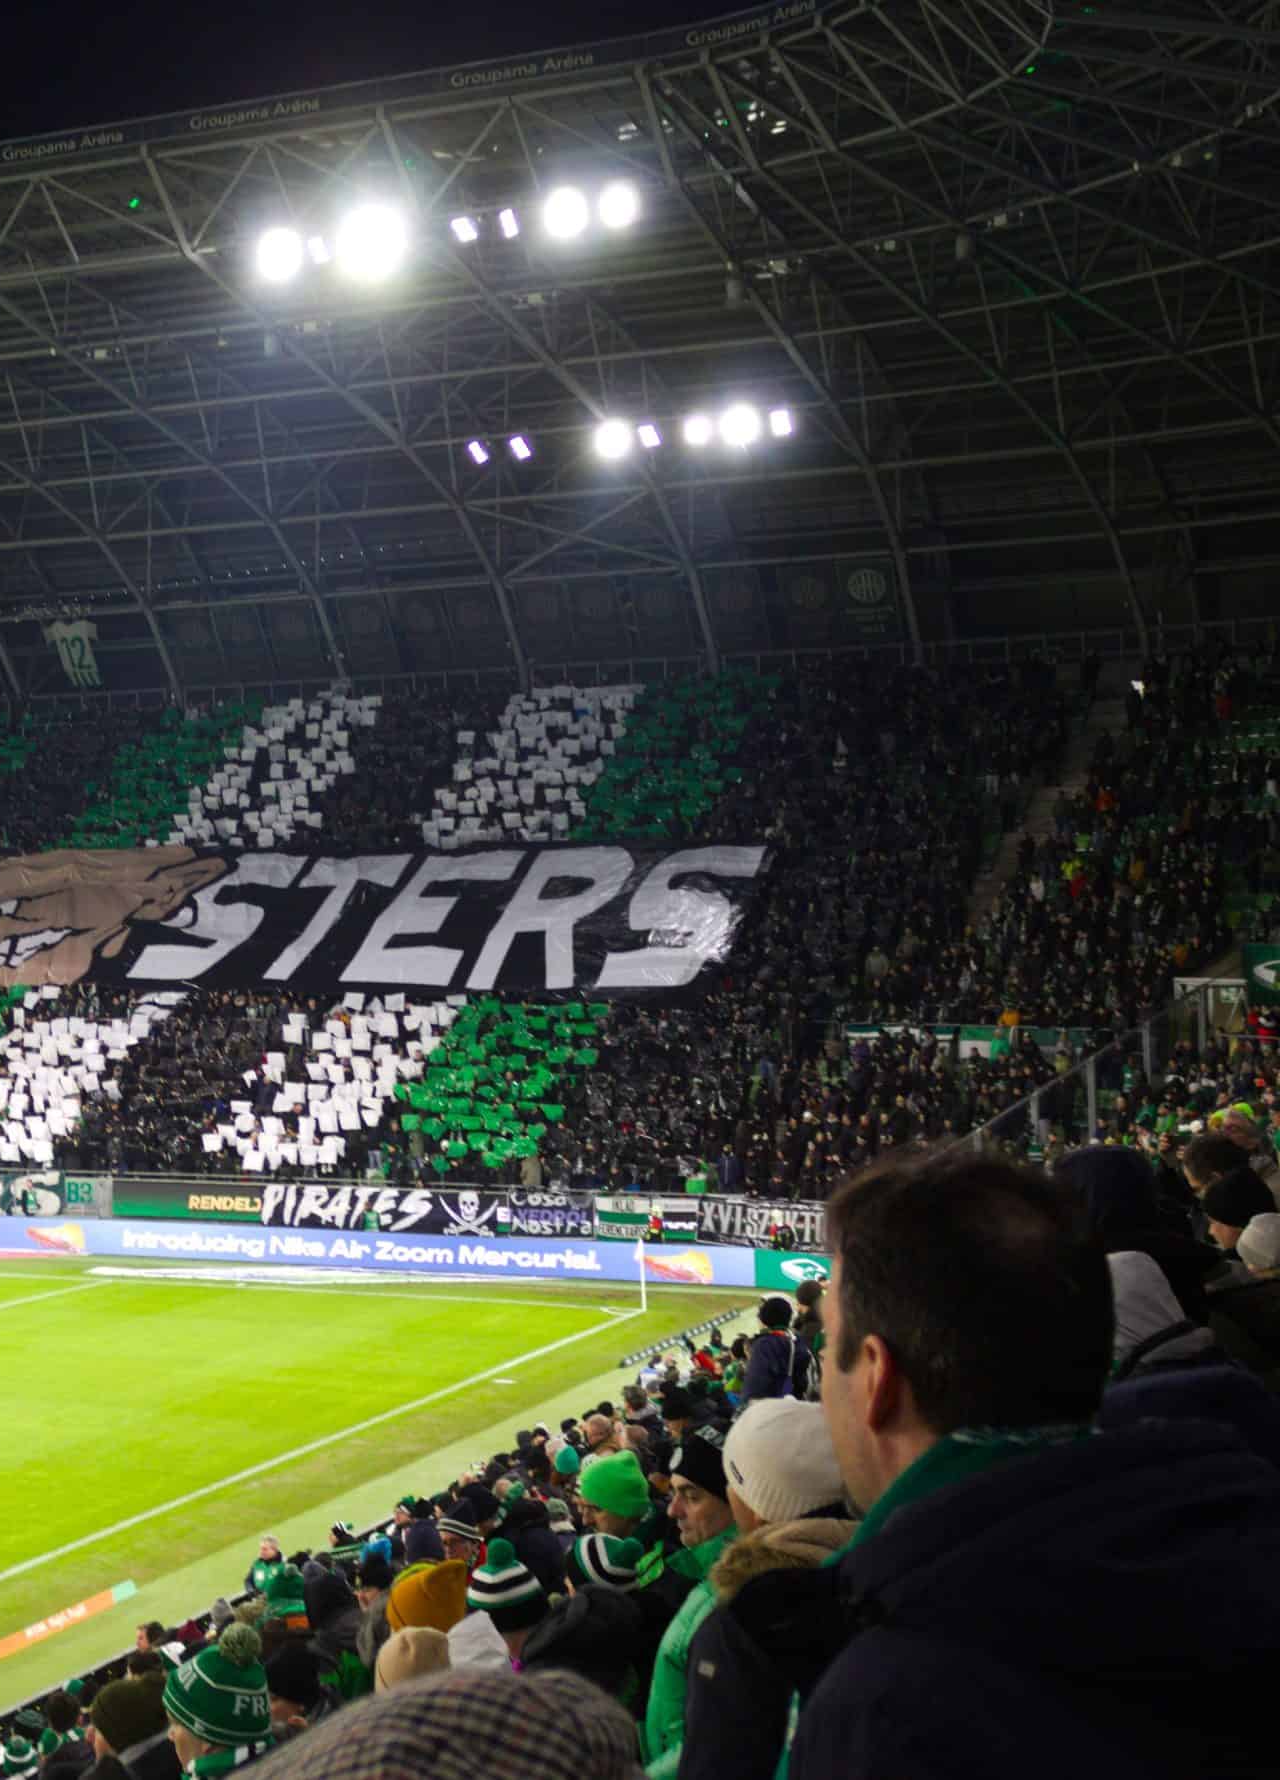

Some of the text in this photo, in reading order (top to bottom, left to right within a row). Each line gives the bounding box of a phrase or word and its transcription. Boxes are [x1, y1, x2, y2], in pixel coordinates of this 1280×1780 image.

[62, 635, 93, 669] 12
[125, 845, 768, 990] STERS
[261, 1184, 433, 1232] PIRATES
[511, 1216, 593, 1236] Nostra
[122, 1229, 266, 1258] Introducing
[269, 1234, 326, 1258] Nike
[329, 1237, 371, 1260] Air
[375, 1240, 454, 1265] Zoom
